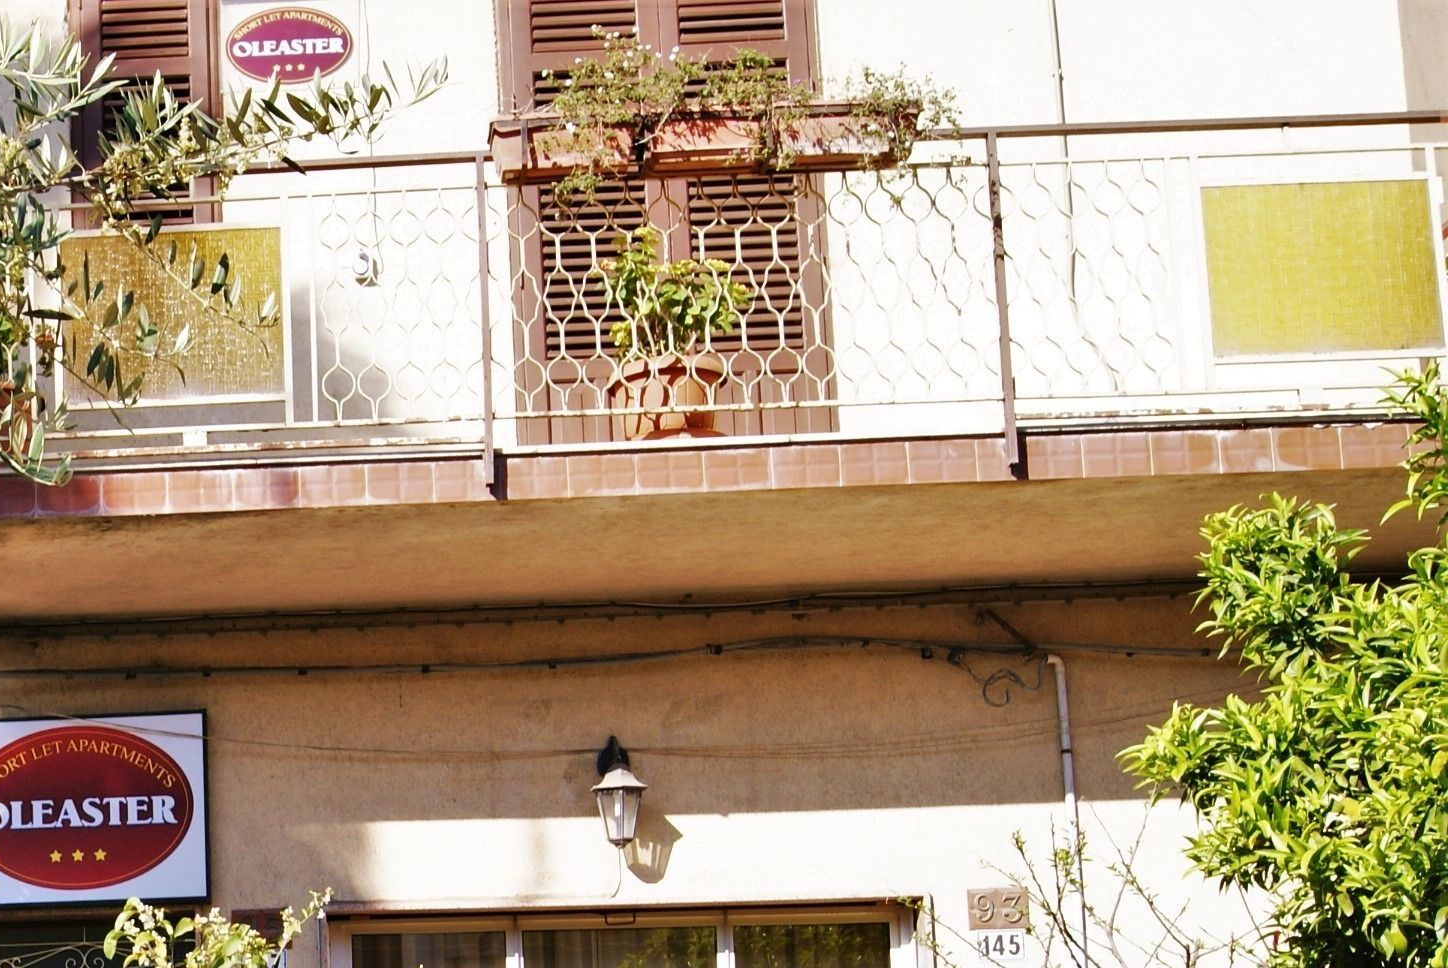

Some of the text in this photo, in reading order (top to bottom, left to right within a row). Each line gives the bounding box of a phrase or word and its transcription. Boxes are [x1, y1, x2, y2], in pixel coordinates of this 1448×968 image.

[233, 11, 344, 40] SHORT LET APARTMENTS
[232, 37, 345, 58] OLEASTER
[31, 740, 63, 760] LET
[67, 738, 177, 788] APARTMENTS
[973, 893, 1023, 923] 93
[983, 934, 1021, 956] 145
